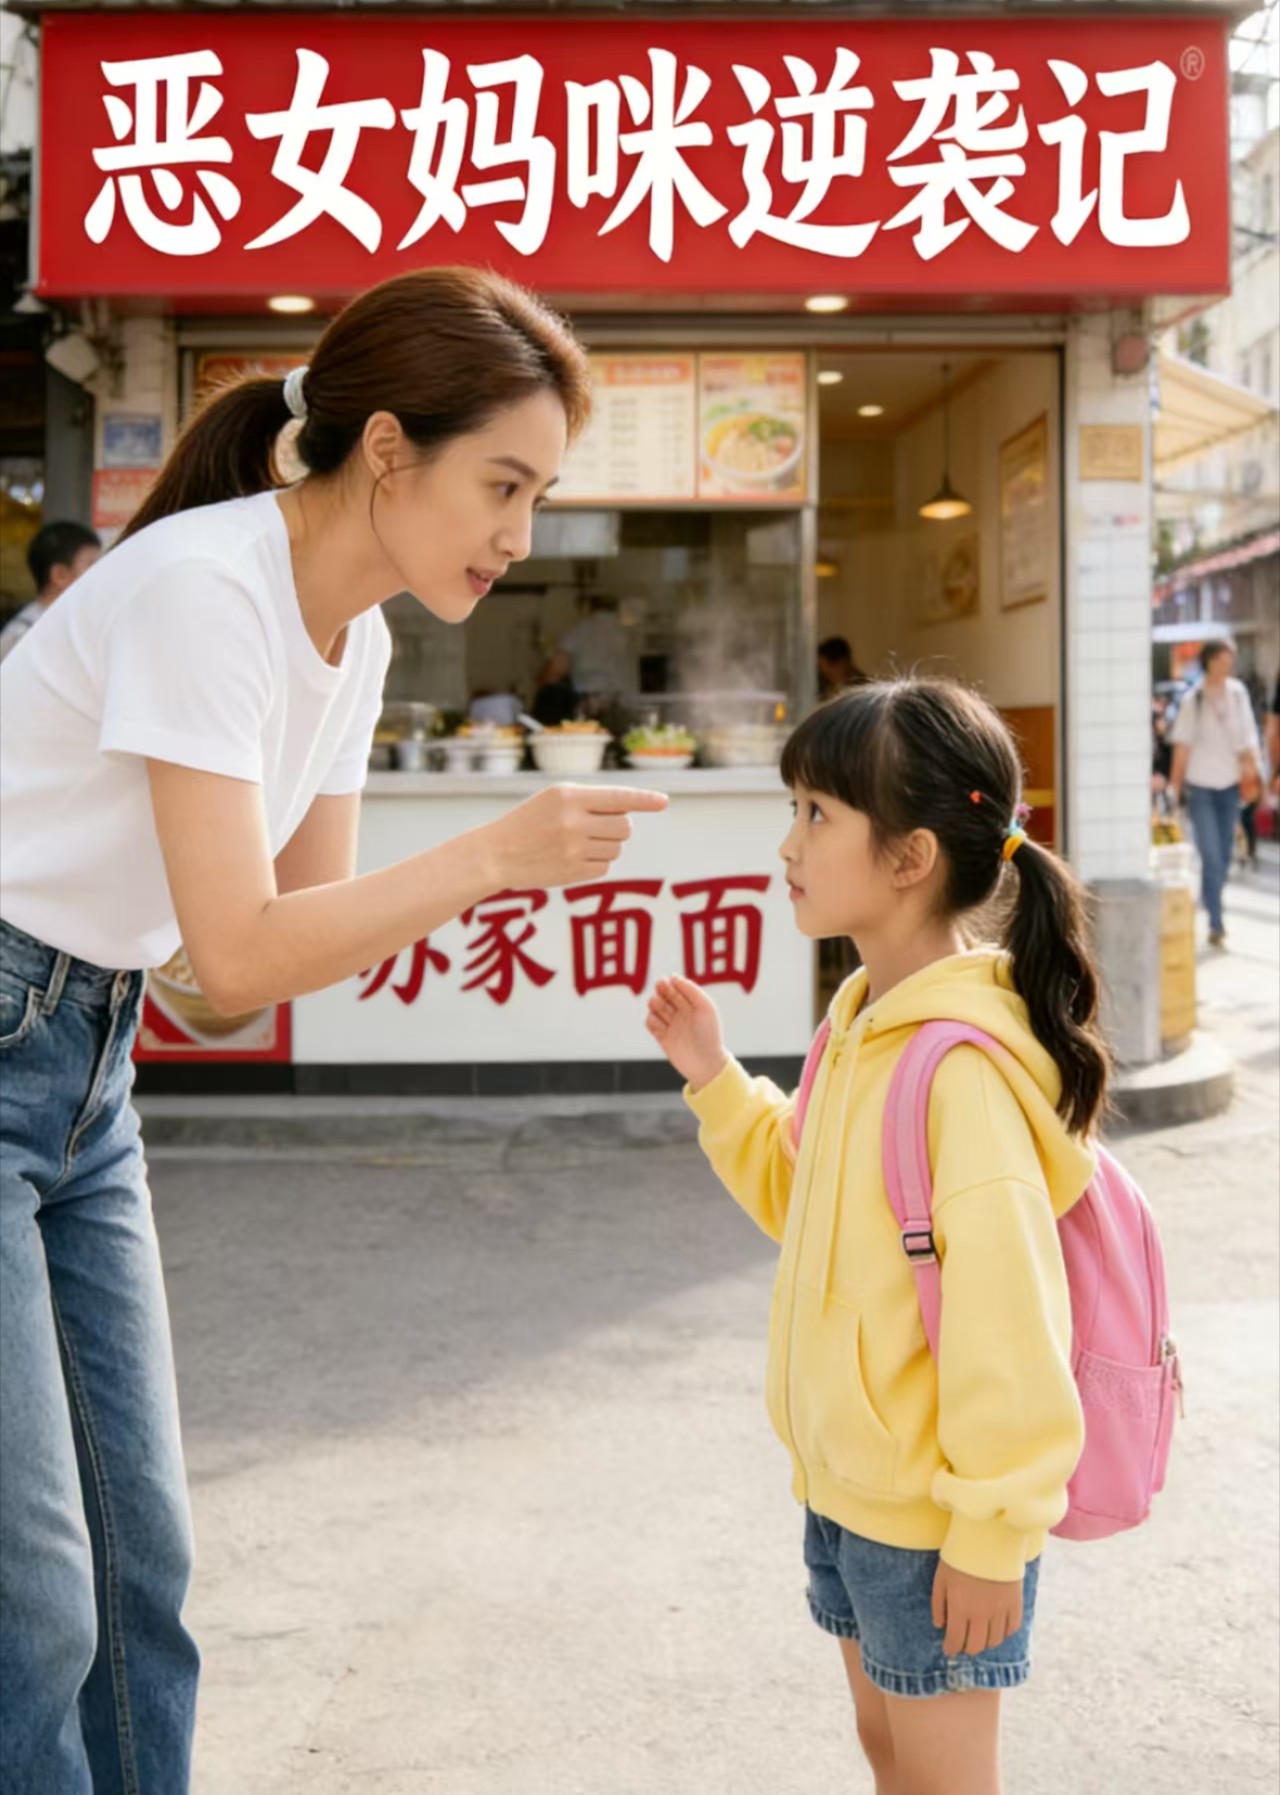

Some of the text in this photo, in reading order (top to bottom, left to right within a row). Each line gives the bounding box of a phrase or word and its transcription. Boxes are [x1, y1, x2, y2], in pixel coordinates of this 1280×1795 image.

[84, 47, 1190, 262] 恶女妈咪逆袭记
